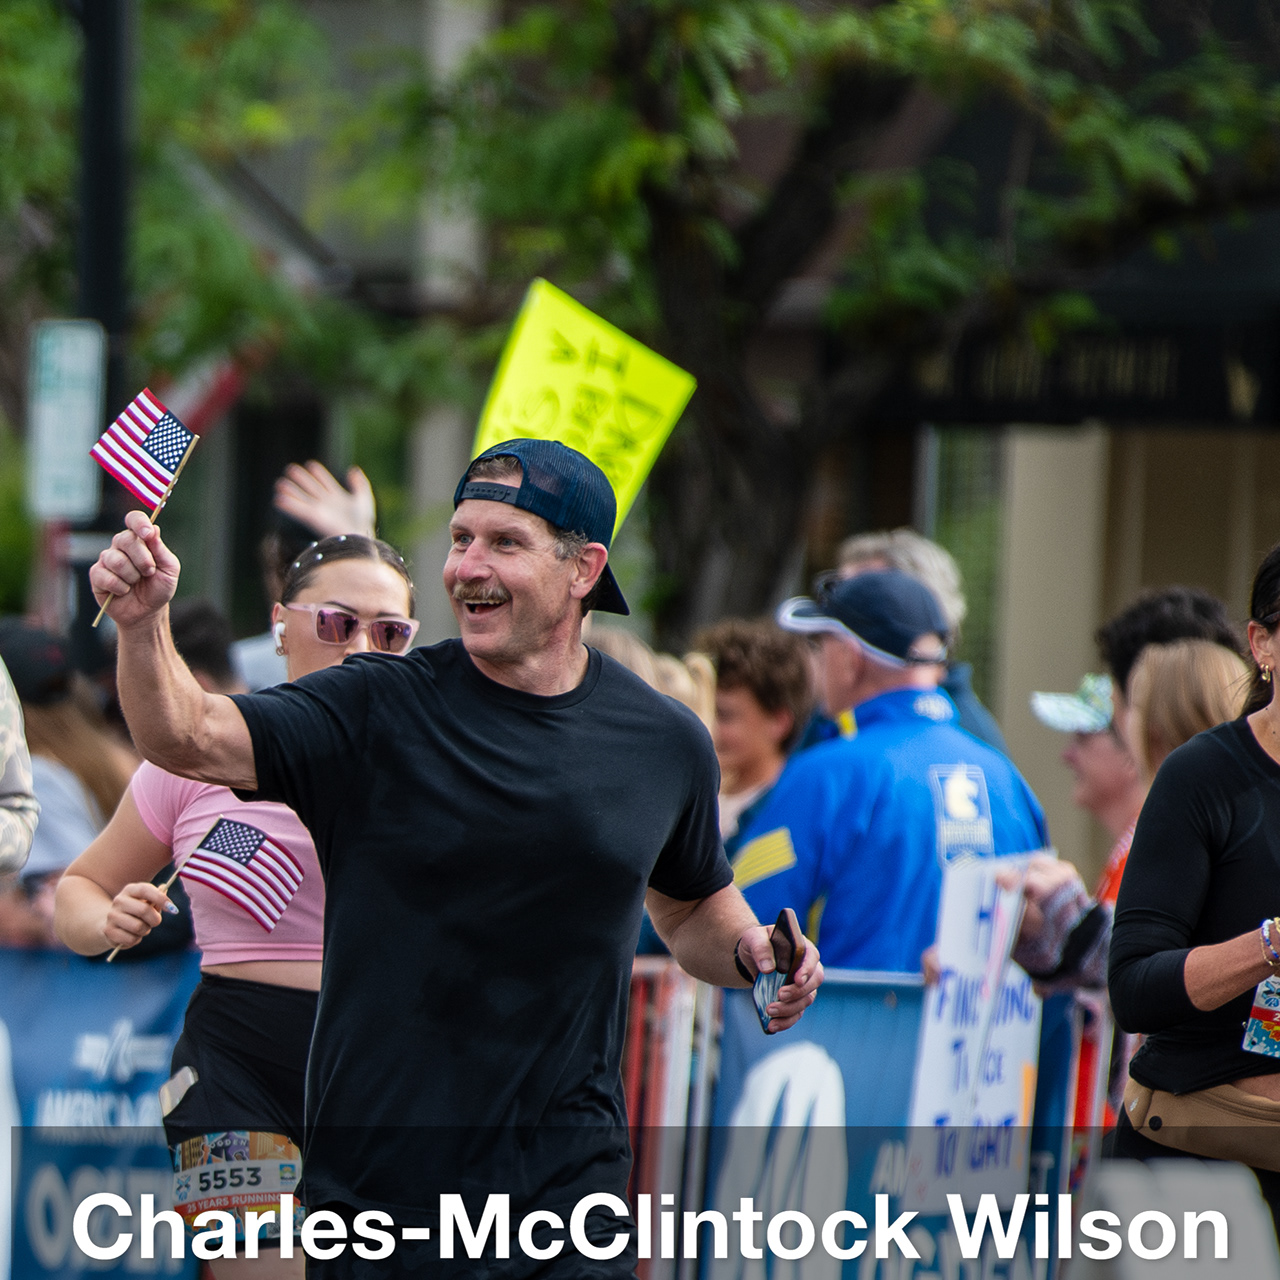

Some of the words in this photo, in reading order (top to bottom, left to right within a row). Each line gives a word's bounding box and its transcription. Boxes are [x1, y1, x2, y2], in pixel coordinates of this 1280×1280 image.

[198, 1166, 262, 1192] 5553
[187, 1202, 198, 1213] 25
[198, 1196, 229, 1208] YEARS
